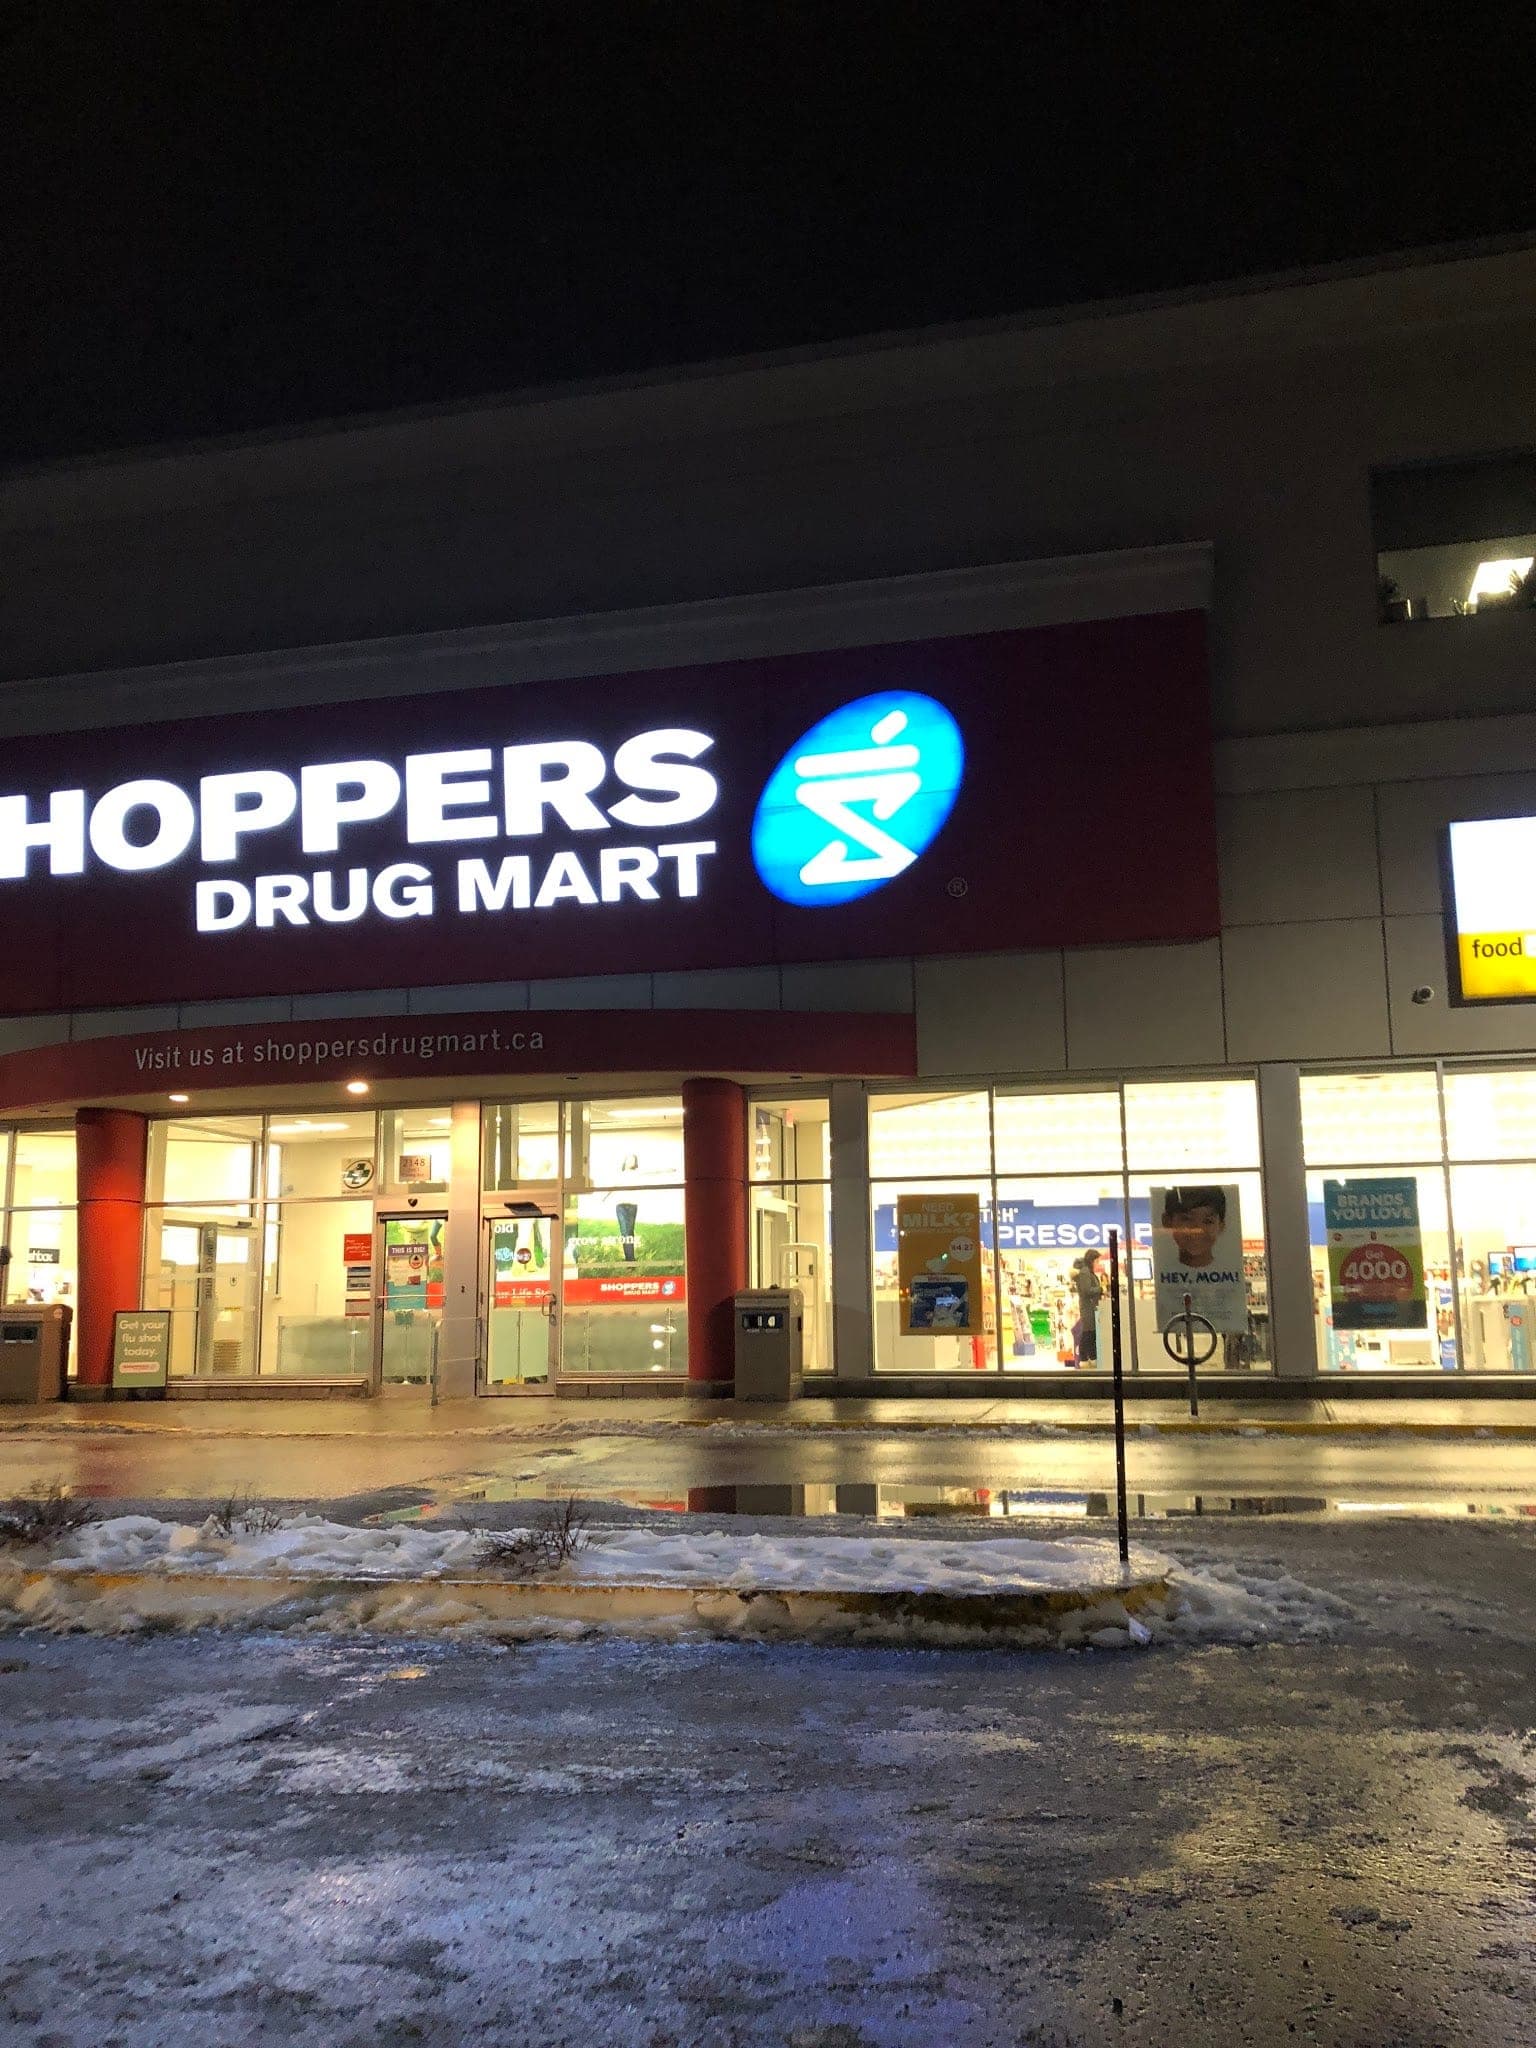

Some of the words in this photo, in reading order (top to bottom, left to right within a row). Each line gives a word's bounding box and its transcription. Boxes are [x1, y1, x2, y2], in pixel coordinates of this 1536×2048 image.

[195, 864, 433, 932] DRUG
[457, 840, 718, 914] MART
[1471, 936, 1523, 958] food
[134, 1046, 181, 1070] Visit
[189, 1048, 214, 1066] us
[221, 1041, 244, 1065] at
[253, 1028, 544, 1065] shoppersdrugmart.ca
[1337, 1192, 1404, 1208] BRANDS
[902, 1212, 976, 1228] MILK?
[1331, 1208, 1367, 1221] YOU
[1370, 1207, 1413, 1220] LOVE
[1160, 1271, 1193, 1284] HEY,
[1196, 1271, 1240, 1284] MOM!
[1344, 1260, 1408, 1280] 4000
[600, 1281, 660, 1292] SHOPPERS
[119, 1320, 139, 1330] Get
[142, 1322, 166, 1331] your
[122, 1332, 136, 1343] flu
[139, 1332, 162, 1342] shot
